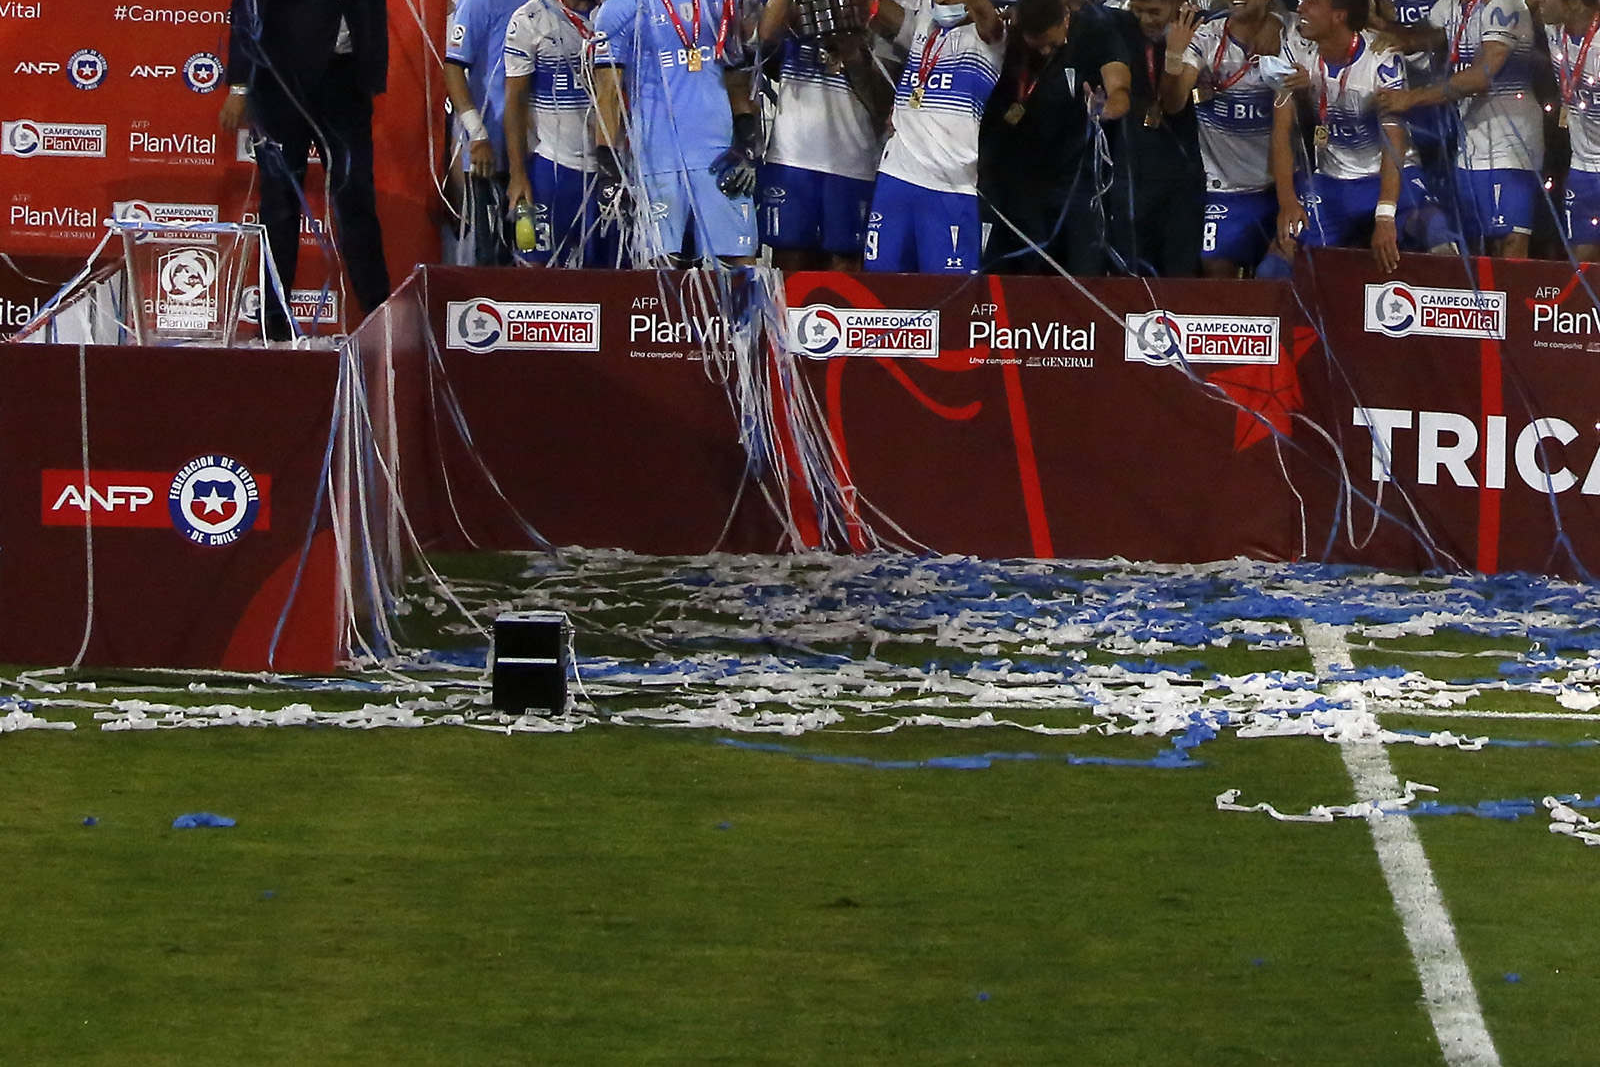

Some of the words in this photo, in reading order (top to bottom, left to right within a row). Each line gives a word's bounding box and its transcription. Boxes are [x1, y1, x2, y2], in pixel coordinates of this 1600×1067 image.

[14, 61, 61, 75] ANFP
[130, 64, 177, 78] ANFP
[910, 72, 953, 90] BCE
[43, 127, 102, 137] CAMPEONATO
[44, 136, 100, 152] PlanVital
[129, 132, 216, 154] PlanVital
[10, 206, 97, 228] PlanVital
[154, 208, 214, 216] CAMPEONATO
[1203, 222, 1218, 252] 8
[1535, 286, 1561, 300] AFP
[631, 297, 658, 310] AFP
[971, 304, 998, 316] AFP
[1420, 295, 1500, 309] CAMPEONATO
[507, 309, 593, 321] CAMPEONATO
[846, 316, 932, 328] CAMPEONATO
[1422, 308, 1498, 331] PlanVital
[508, 322, 592, 343] PlanVital
[630, 314, 735, 344] PlanVit
[969, 321, 1096, 352] PlanVital
[1186, 323, 1272, 335] CAMPEONATO
[848, 329, 930, 350] PlanVital
[1187, 335, 1271, 356] PlanVital
[1042, 357, 1094, 368] GENERALI
[169, 455, 214, 500] FEDERACION
[221, 456, 235, 470] DE
[236, 465, 259, 501] FUTBOL
[52, 484, 154, 512] ANFP
[191, 530, 205, 544] DE
[210, 530, 239, 546] CHILE
